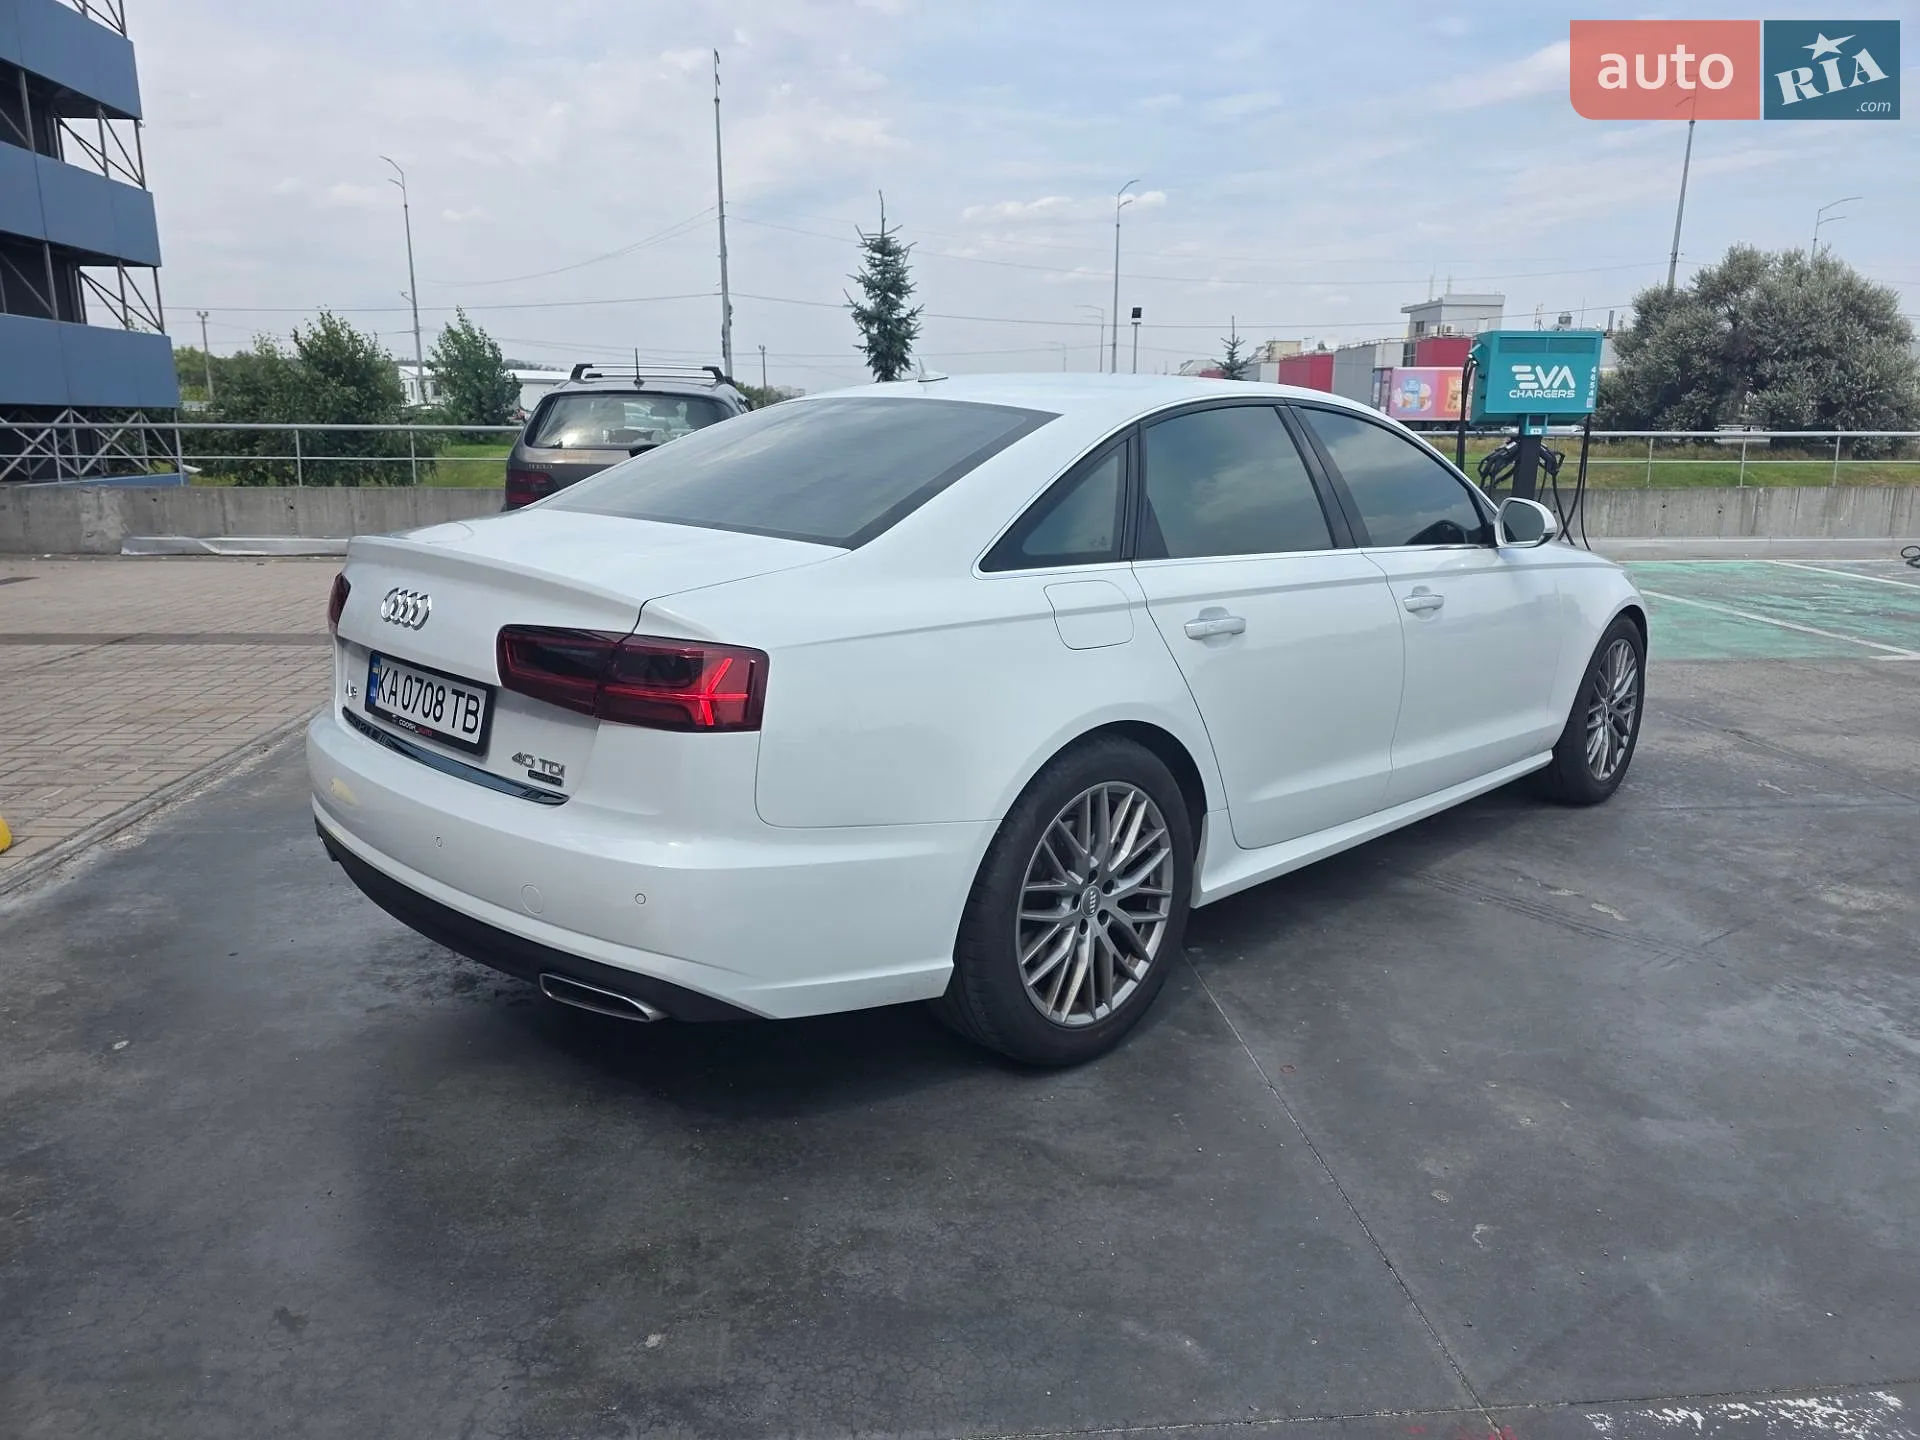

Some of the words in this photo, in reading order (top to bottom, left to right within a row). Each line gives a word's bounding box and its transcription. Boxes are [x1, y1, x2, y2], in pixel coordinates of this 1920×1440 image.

[1511, 365, 1576, 389] EVA
[1509, 389, 1576, 399] CHARGERS
[377, 664, 398, 707] KA
[401, 674, 446, 723] 0708
[450, 687, 480, 734] TB
[511, 751, 536, 769] 40
[538, 758, 566, 779] TDI
